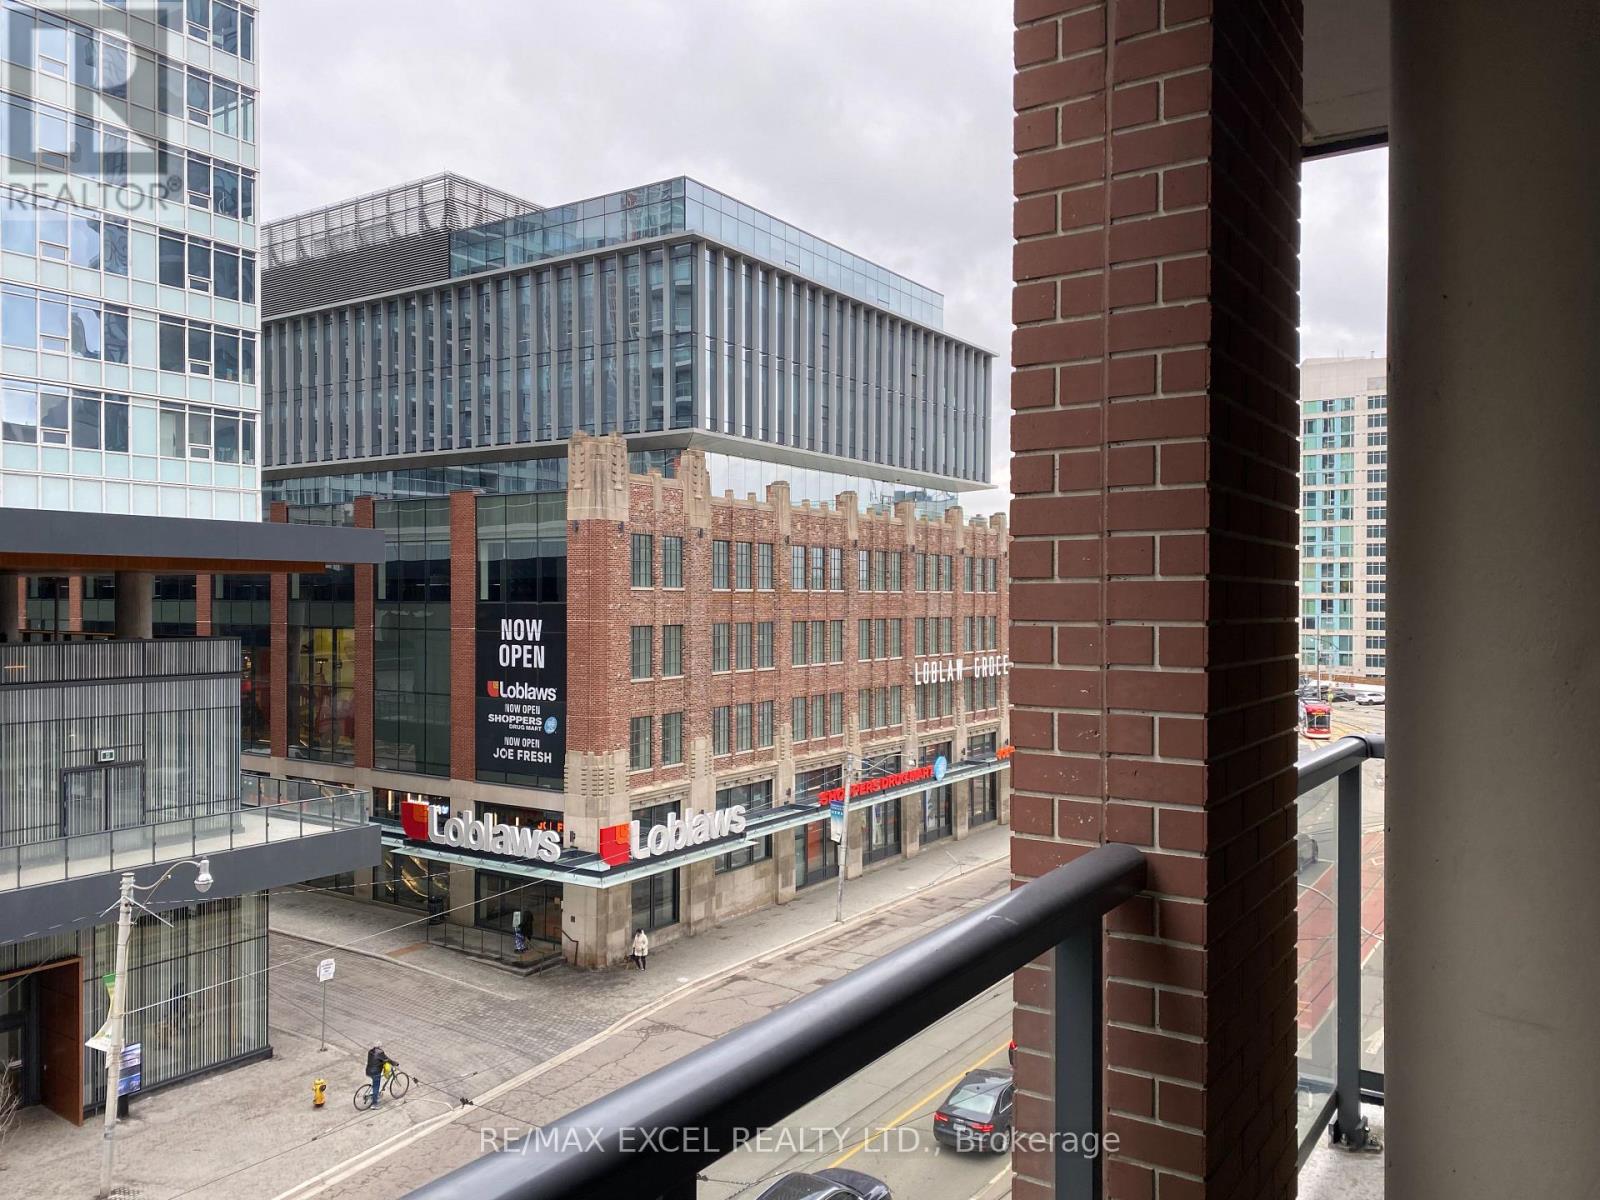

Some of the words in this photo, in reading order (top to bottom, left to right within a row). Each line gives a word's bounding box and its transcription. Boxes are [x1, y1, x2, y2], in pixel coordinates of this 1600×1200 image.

[501, 619, 542, 642] NOW
[499, 644, 545, 669] OPEN
[915, 658, 963, 686] LOBLAW
[974, 655, 1009, 678] GROCE
[500, 681, 557, 701] Loblaws
[488, 714, 543, 726] SHOPPERS
[505, 703, 520, 713] NOW
[522, 704, 541, 715] OPEN
[504, 736, 520, 747] NOW
[521, 738, 540, 749] OPEN
[493, 748, 514, 760] JOE
[517, 749, 552, 764] FRESH
[817, 778, 881, 806] SHOPERS
[428, 805, 561, 863] Loblaws
[630, 804, 746, 860] Loblaws
